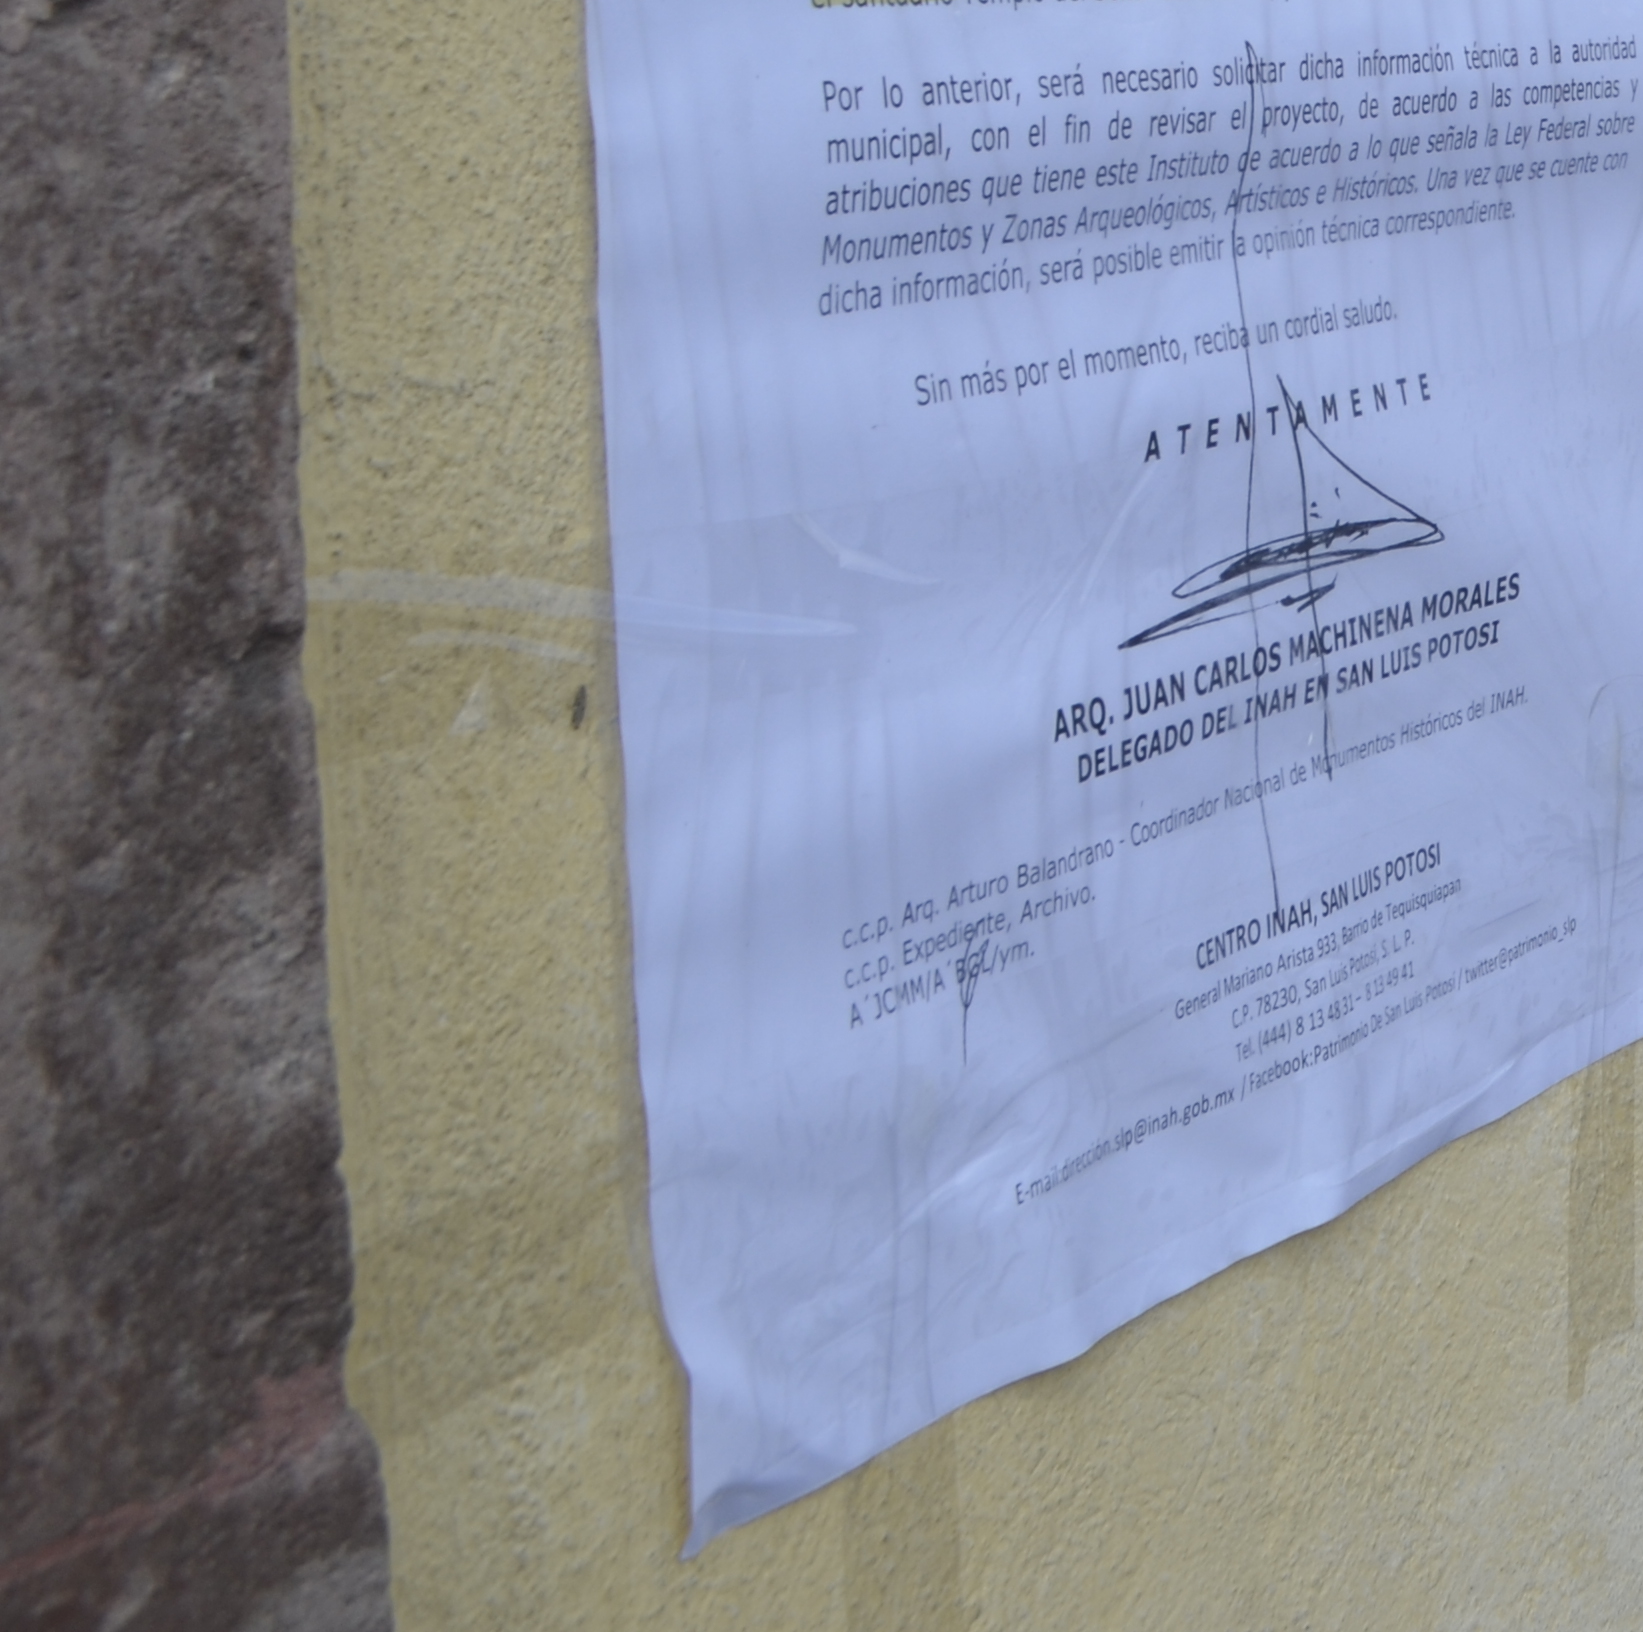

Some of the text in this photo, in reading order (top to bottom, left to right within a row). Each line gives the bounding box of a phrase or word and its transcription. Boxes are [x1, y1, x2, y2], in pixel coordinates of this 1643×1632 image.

[822, 35, 1637, 112] Por lo anterior, será necesario solicitar dicha información técnica a la autoridad
[1054, 572, 1521, 742] ARQ. JUAN CARLOS MACHINENA MORALES
[1077, 619, 1500, 784] DELEGADO DEL INAH EN SAN LUIS POTOSI
[844, 883, 1097, 990] c.c.p. Expediente, Archivo.
[1175, 878, 1461, 1020] General Mariano Arista 933, Barrio de Tequisquiapan
[1196, 842, 1440, 970] CENTRO INAH, SAN LUIS POTOSI
